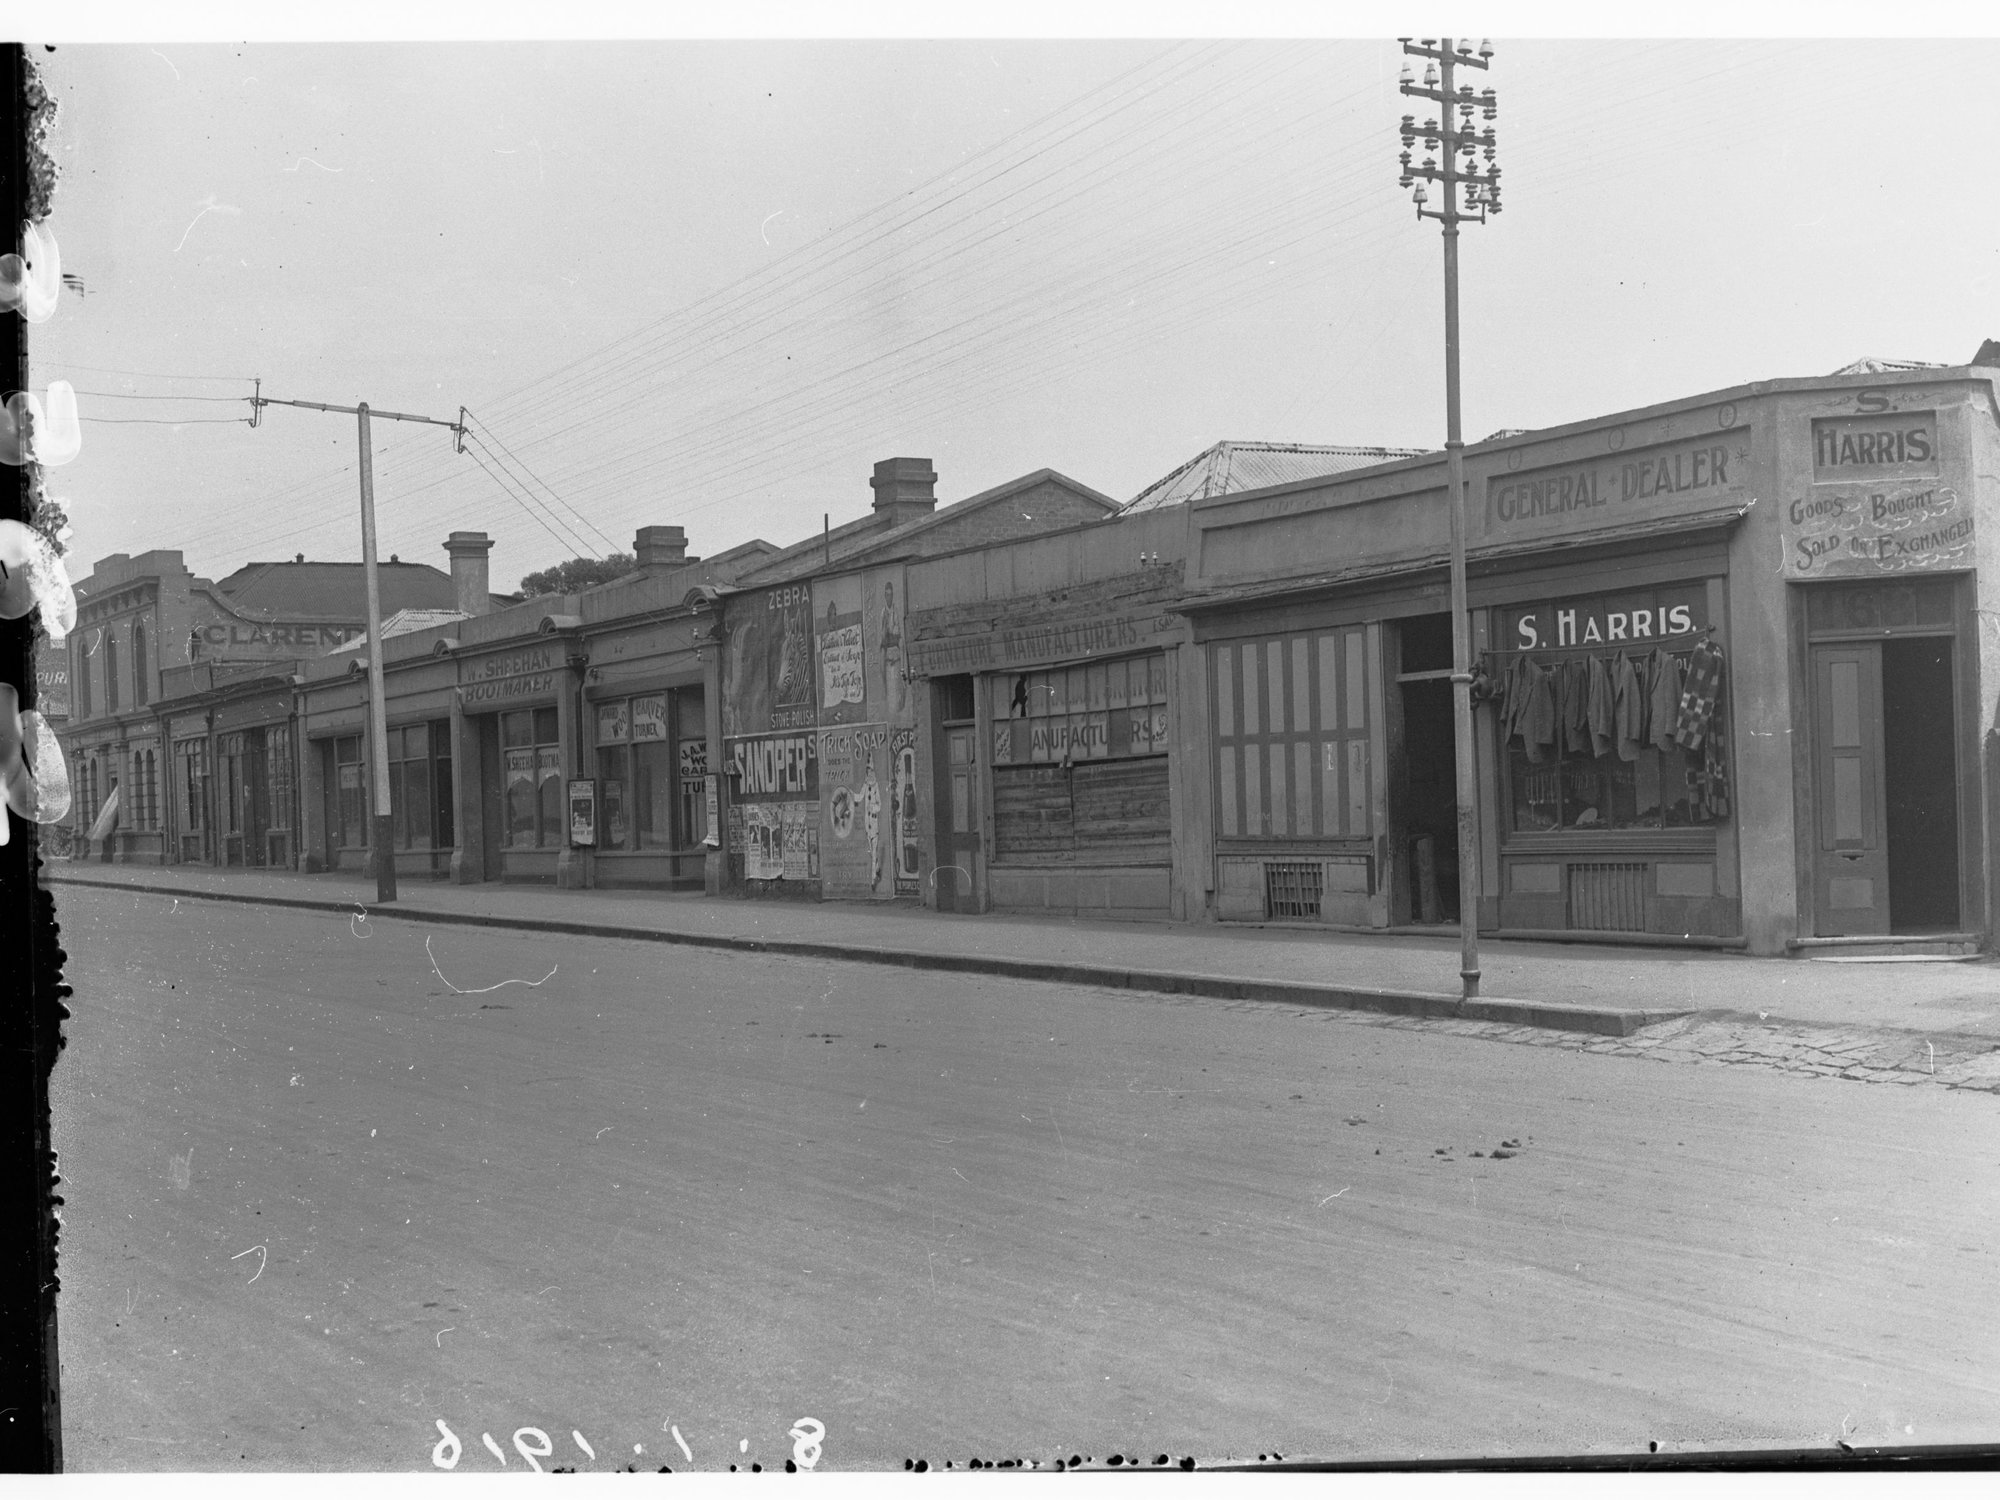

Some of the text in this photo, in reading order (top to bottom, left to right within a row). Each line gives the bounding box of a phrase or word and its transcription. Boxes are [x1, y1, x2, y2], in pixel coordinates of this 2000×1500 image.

[1854, 390, 1908, 413] S.
[1817, 428, 1936, 467] HARRIS.
[1496, 445, 1729, 523] GENERAL DEALER
[1871, 489, 1935, 521] BOUGHT
[1796, 535, 1840, 570] SOLD
[768, 585, 810, 609] ZEBRA
[1517, 604, 1698, 651] S. HARRIS.
[485, 650, 551, 678] SHEEHAN
[917, 636, 996, 672] FURNITURE
[465, 675, 553, 703] BOOTMAKER
[634, 722, 659, 738] TURNER
[771, 712, 790, 729] STOVE
[820, 730, 885, 764] TRICK SOAP
